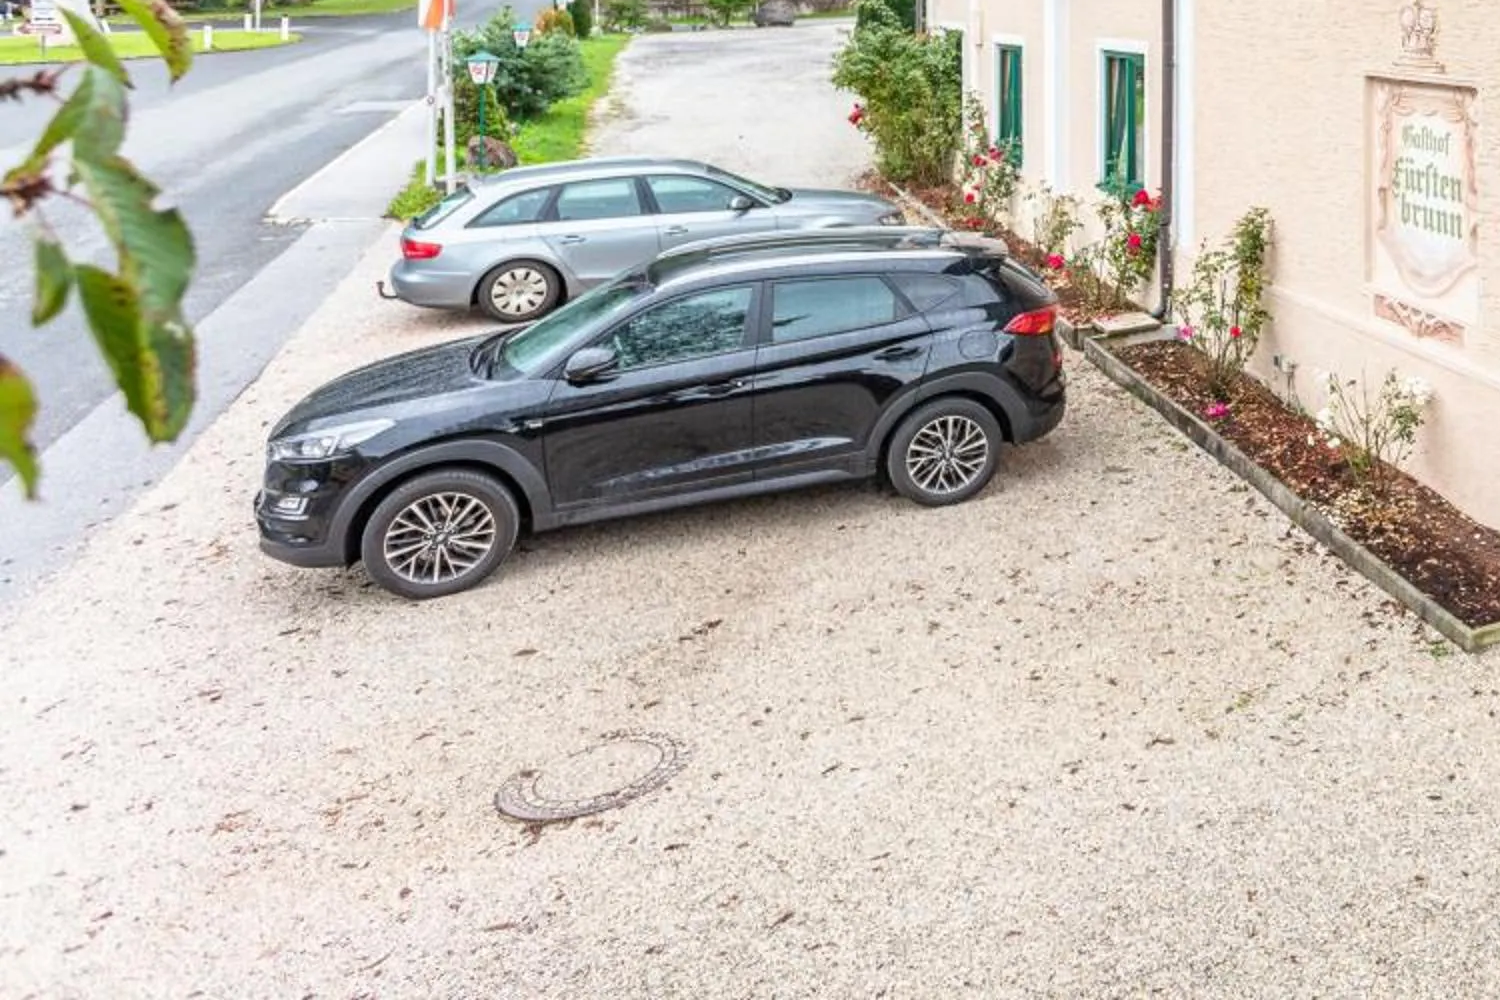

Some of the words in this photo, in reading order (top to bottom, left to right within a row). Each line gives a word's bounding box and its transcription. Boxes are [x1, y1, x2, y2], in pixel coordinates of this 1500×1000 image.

[1402, 124, 1451, 155] Gasthof
[1391, 156, 1462, 203] Fürsten
[1401, 192, 1462, 240] brunn
